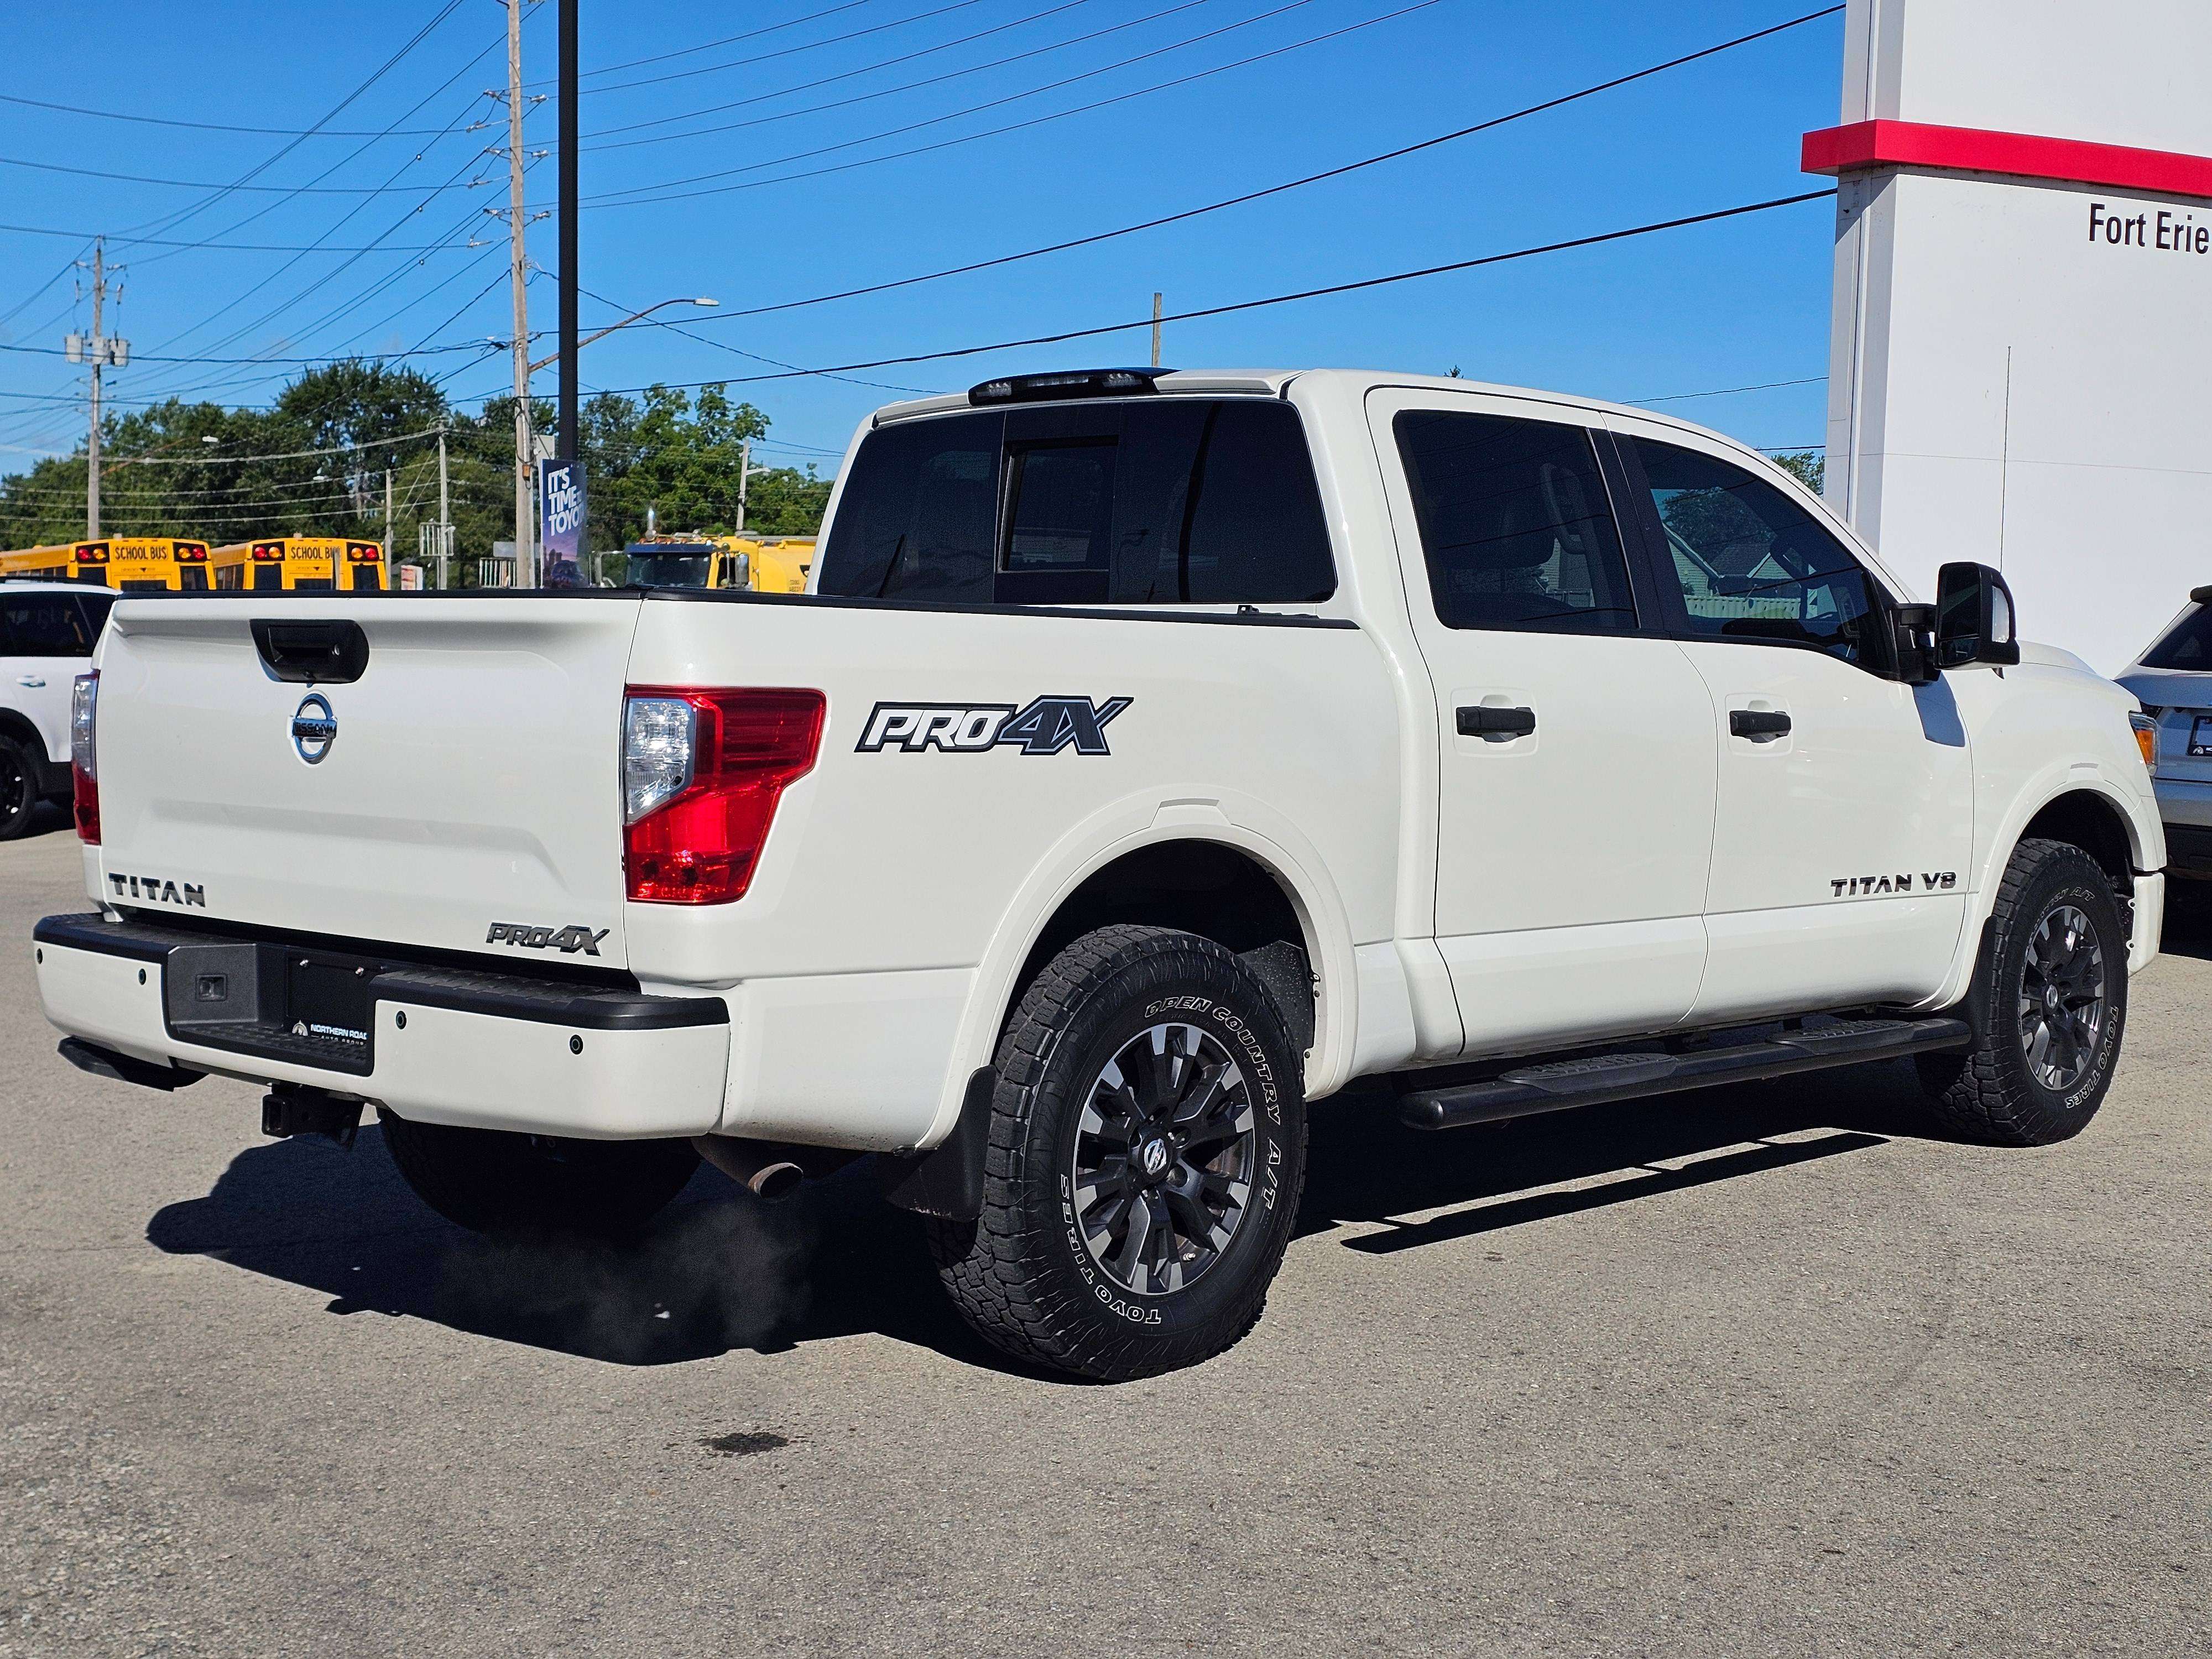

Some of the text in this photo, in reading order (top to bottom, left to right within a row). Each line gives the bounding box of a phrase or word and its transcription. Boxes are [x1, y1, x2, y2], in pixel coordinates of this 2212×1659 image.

[2089, 203, 2209, 254] Fort Erie
[548, 467, 570, 494] IT'S
[549, 485, 577, 514] TIME
[114, 546, 168, 560] SCHOOL BUS
[291, 546, 322, 560] SCHOOL
[108, 872, 206, 907] TITAN
[1830, 872, 1957, 897] TITAN V8
[310, 1024, 348, 1037] NORTHERN
[2064, 1005, 2119, 1109] TOYO TIRES
[1145, 995, 1213, 1018] OPEN
[1212, 1006, 1281, 1126] COUNTRY
[1262, 1136, 1281, 1210] A/T
[1060, 1173, 1162, 1324] TOYO TIRES
